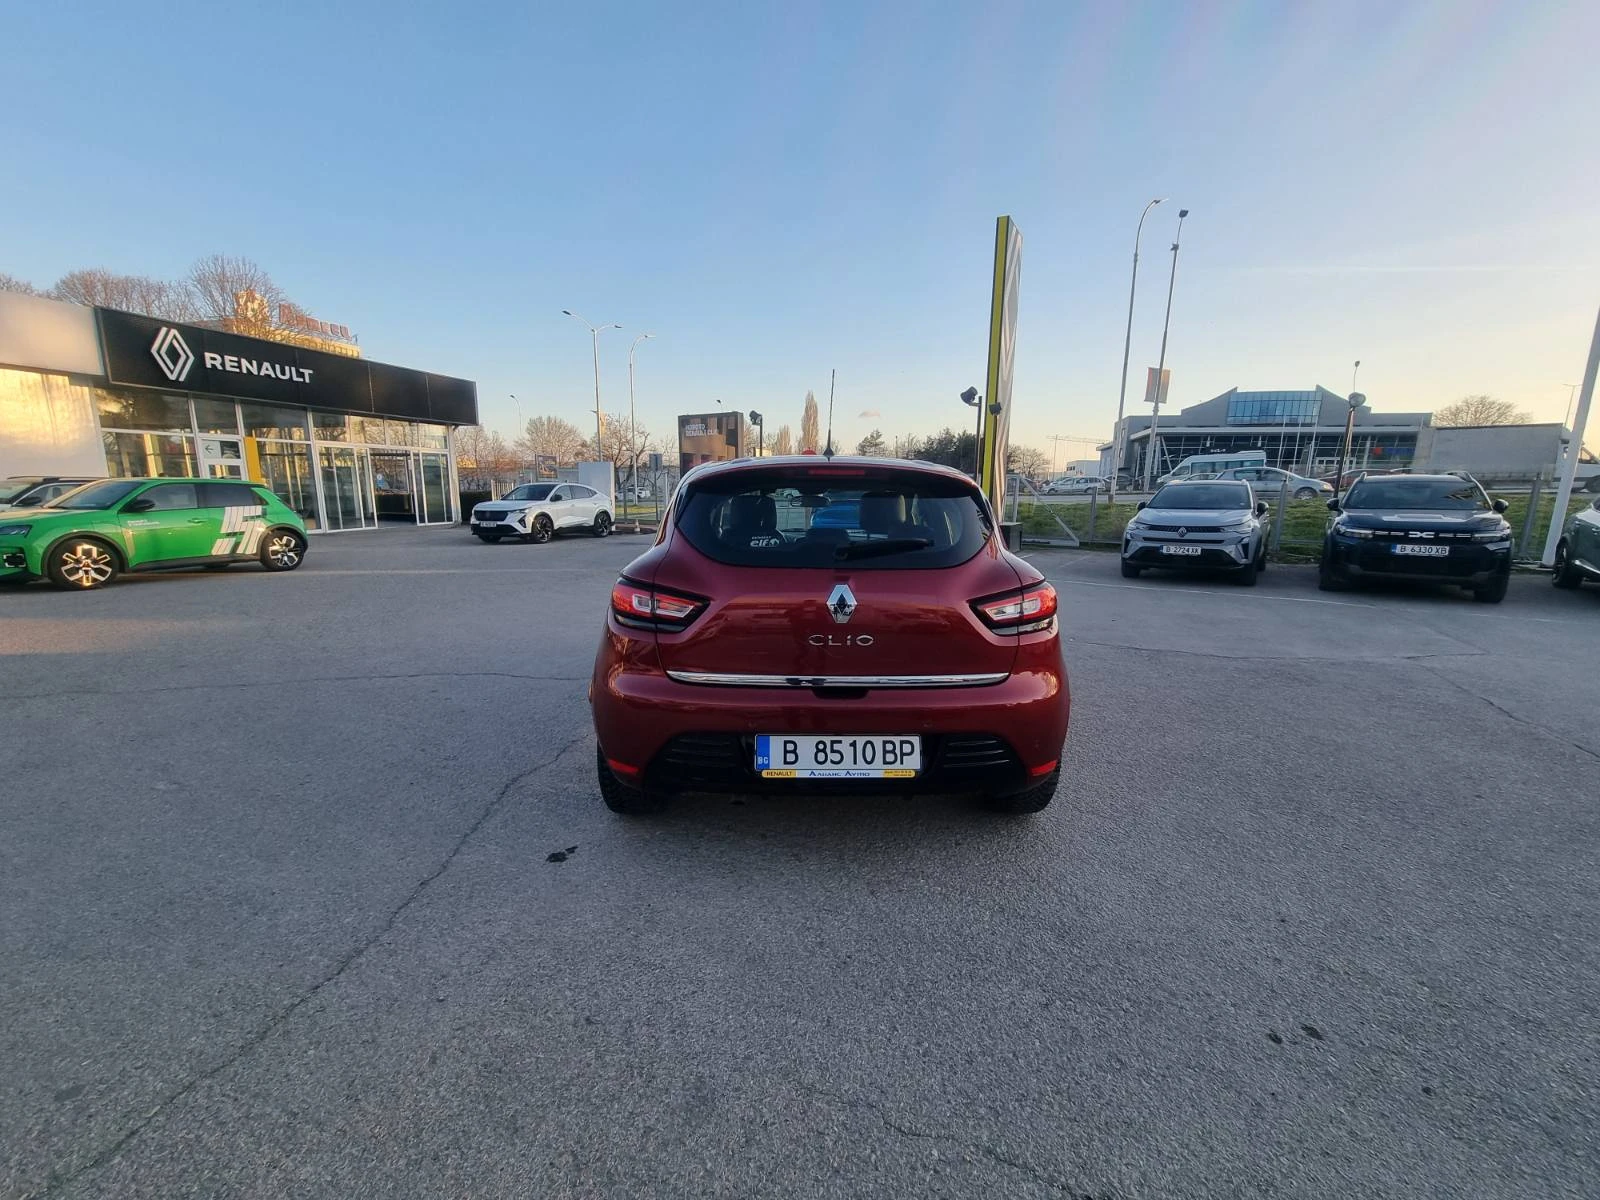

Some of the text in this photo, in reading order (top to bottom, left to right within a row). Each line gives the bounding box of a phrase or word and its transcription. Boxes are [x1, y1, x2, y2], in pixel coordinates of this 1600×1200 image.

[204, 351, 314, 384] RENAULT
[757, 756, 769, 764] BG
[783, 740, 915, 765] B 8510 BP
